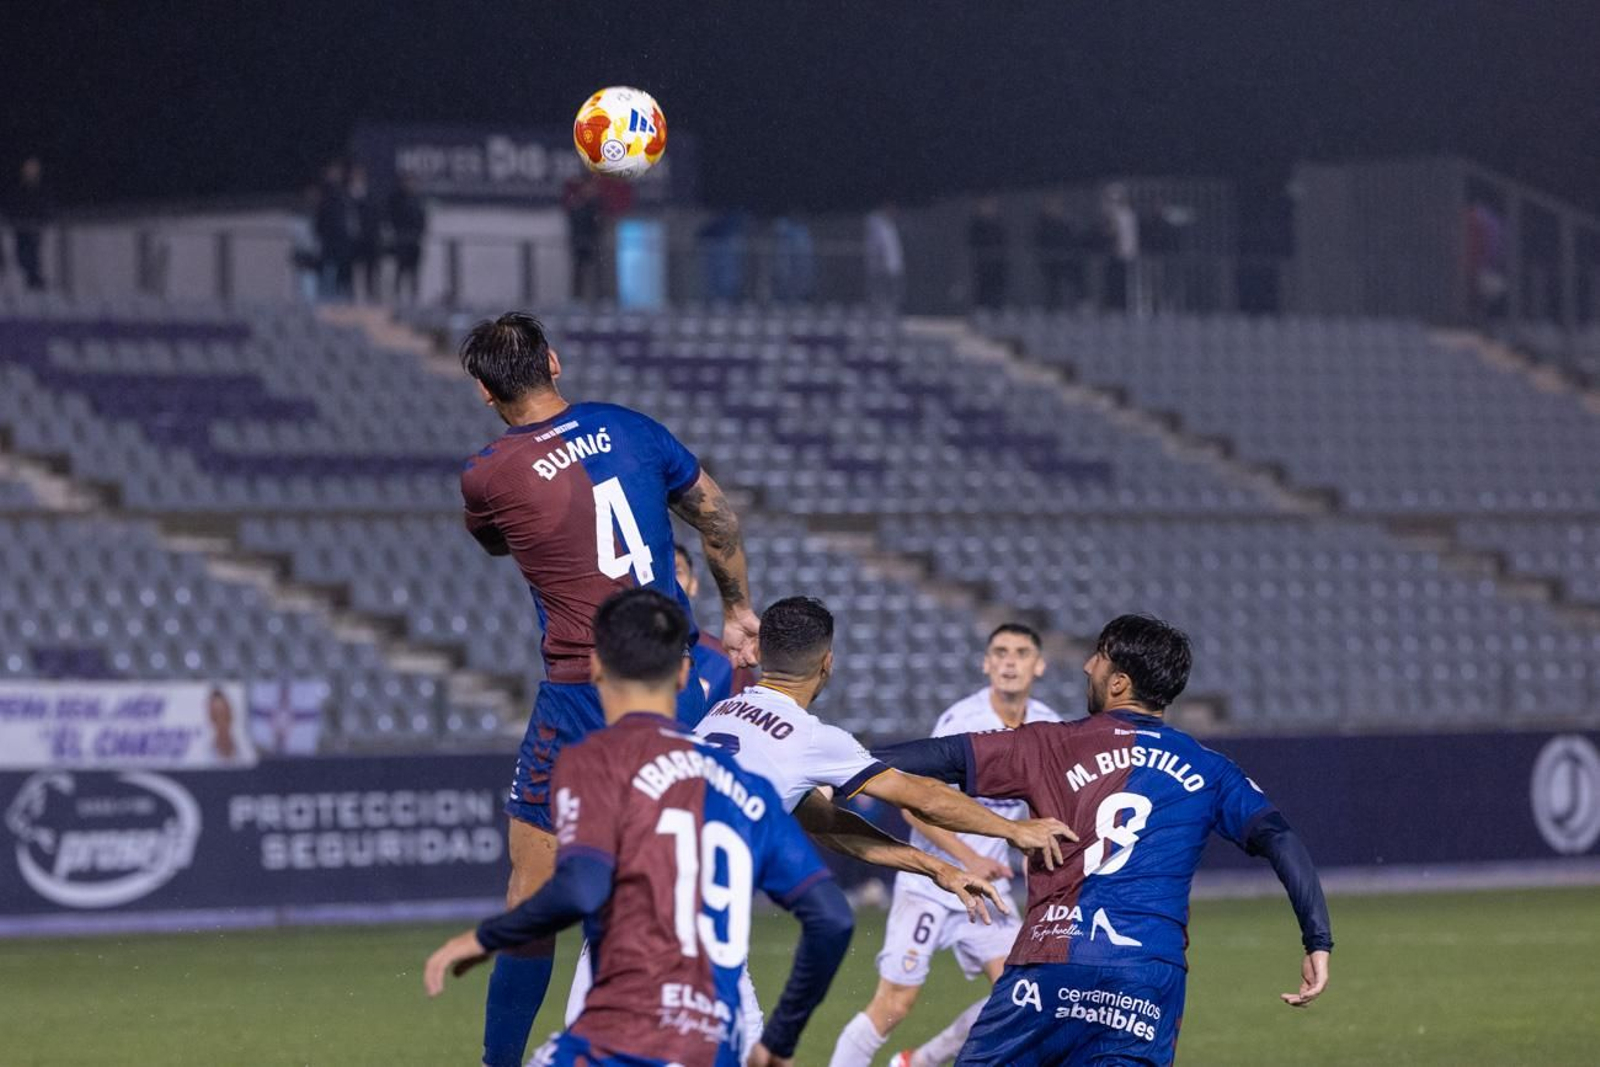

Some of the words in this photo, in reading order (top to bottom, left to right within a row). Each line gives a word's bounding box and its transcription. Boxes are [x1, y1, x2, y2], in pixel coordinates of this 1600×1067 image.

[532, 427, 611, 481] ĐUMIĆ
[592, 476, 655, 586] 4
[632, 750, 766, 821] IBARRONDO
[1066, 763, 1098, 793] M.
[1095, 746, 1205, 793] BUSTILLO
[261, 827, 502, 870] SEGURIDAD
[1083, 792, 1152, 876] 8
[655, 807, 753, 969] 19
[913, 912, 935, 945] 6
[661, 983, 732, 1022] ELDA
[1055, 1002, 1155, 1041] abatibles
[1058, 987, 1161, 1020] cerramientos
